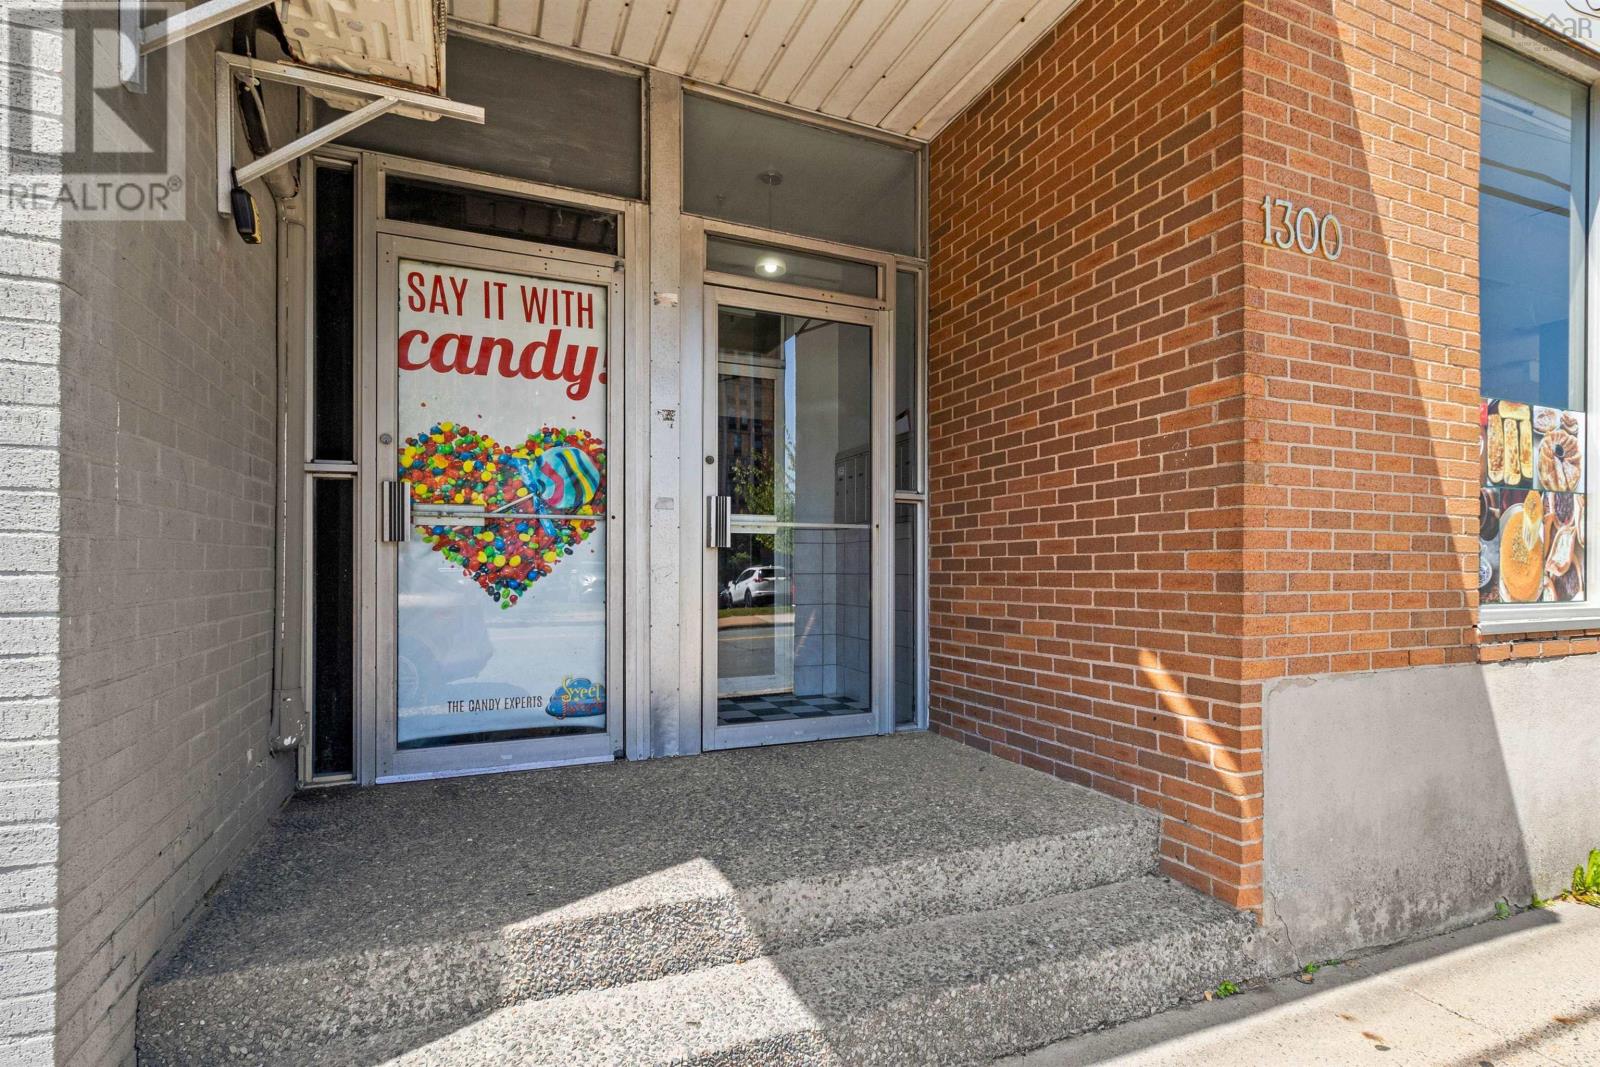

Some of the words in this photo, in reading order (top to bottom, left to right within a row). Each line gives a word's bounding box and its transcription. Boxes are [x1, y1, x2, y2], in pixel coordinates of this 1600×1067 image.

[1261, 194, 1343, 261] 1300
[407, 271, 469, 317] SAY
[483, 280, 508, 321] IT
[520, 285, 594, 329] WITH
[447, 700, 465, 713] THE
[468, 698, 500, 712] CANDY
[504, 695, 543, 709] EXPERTS
